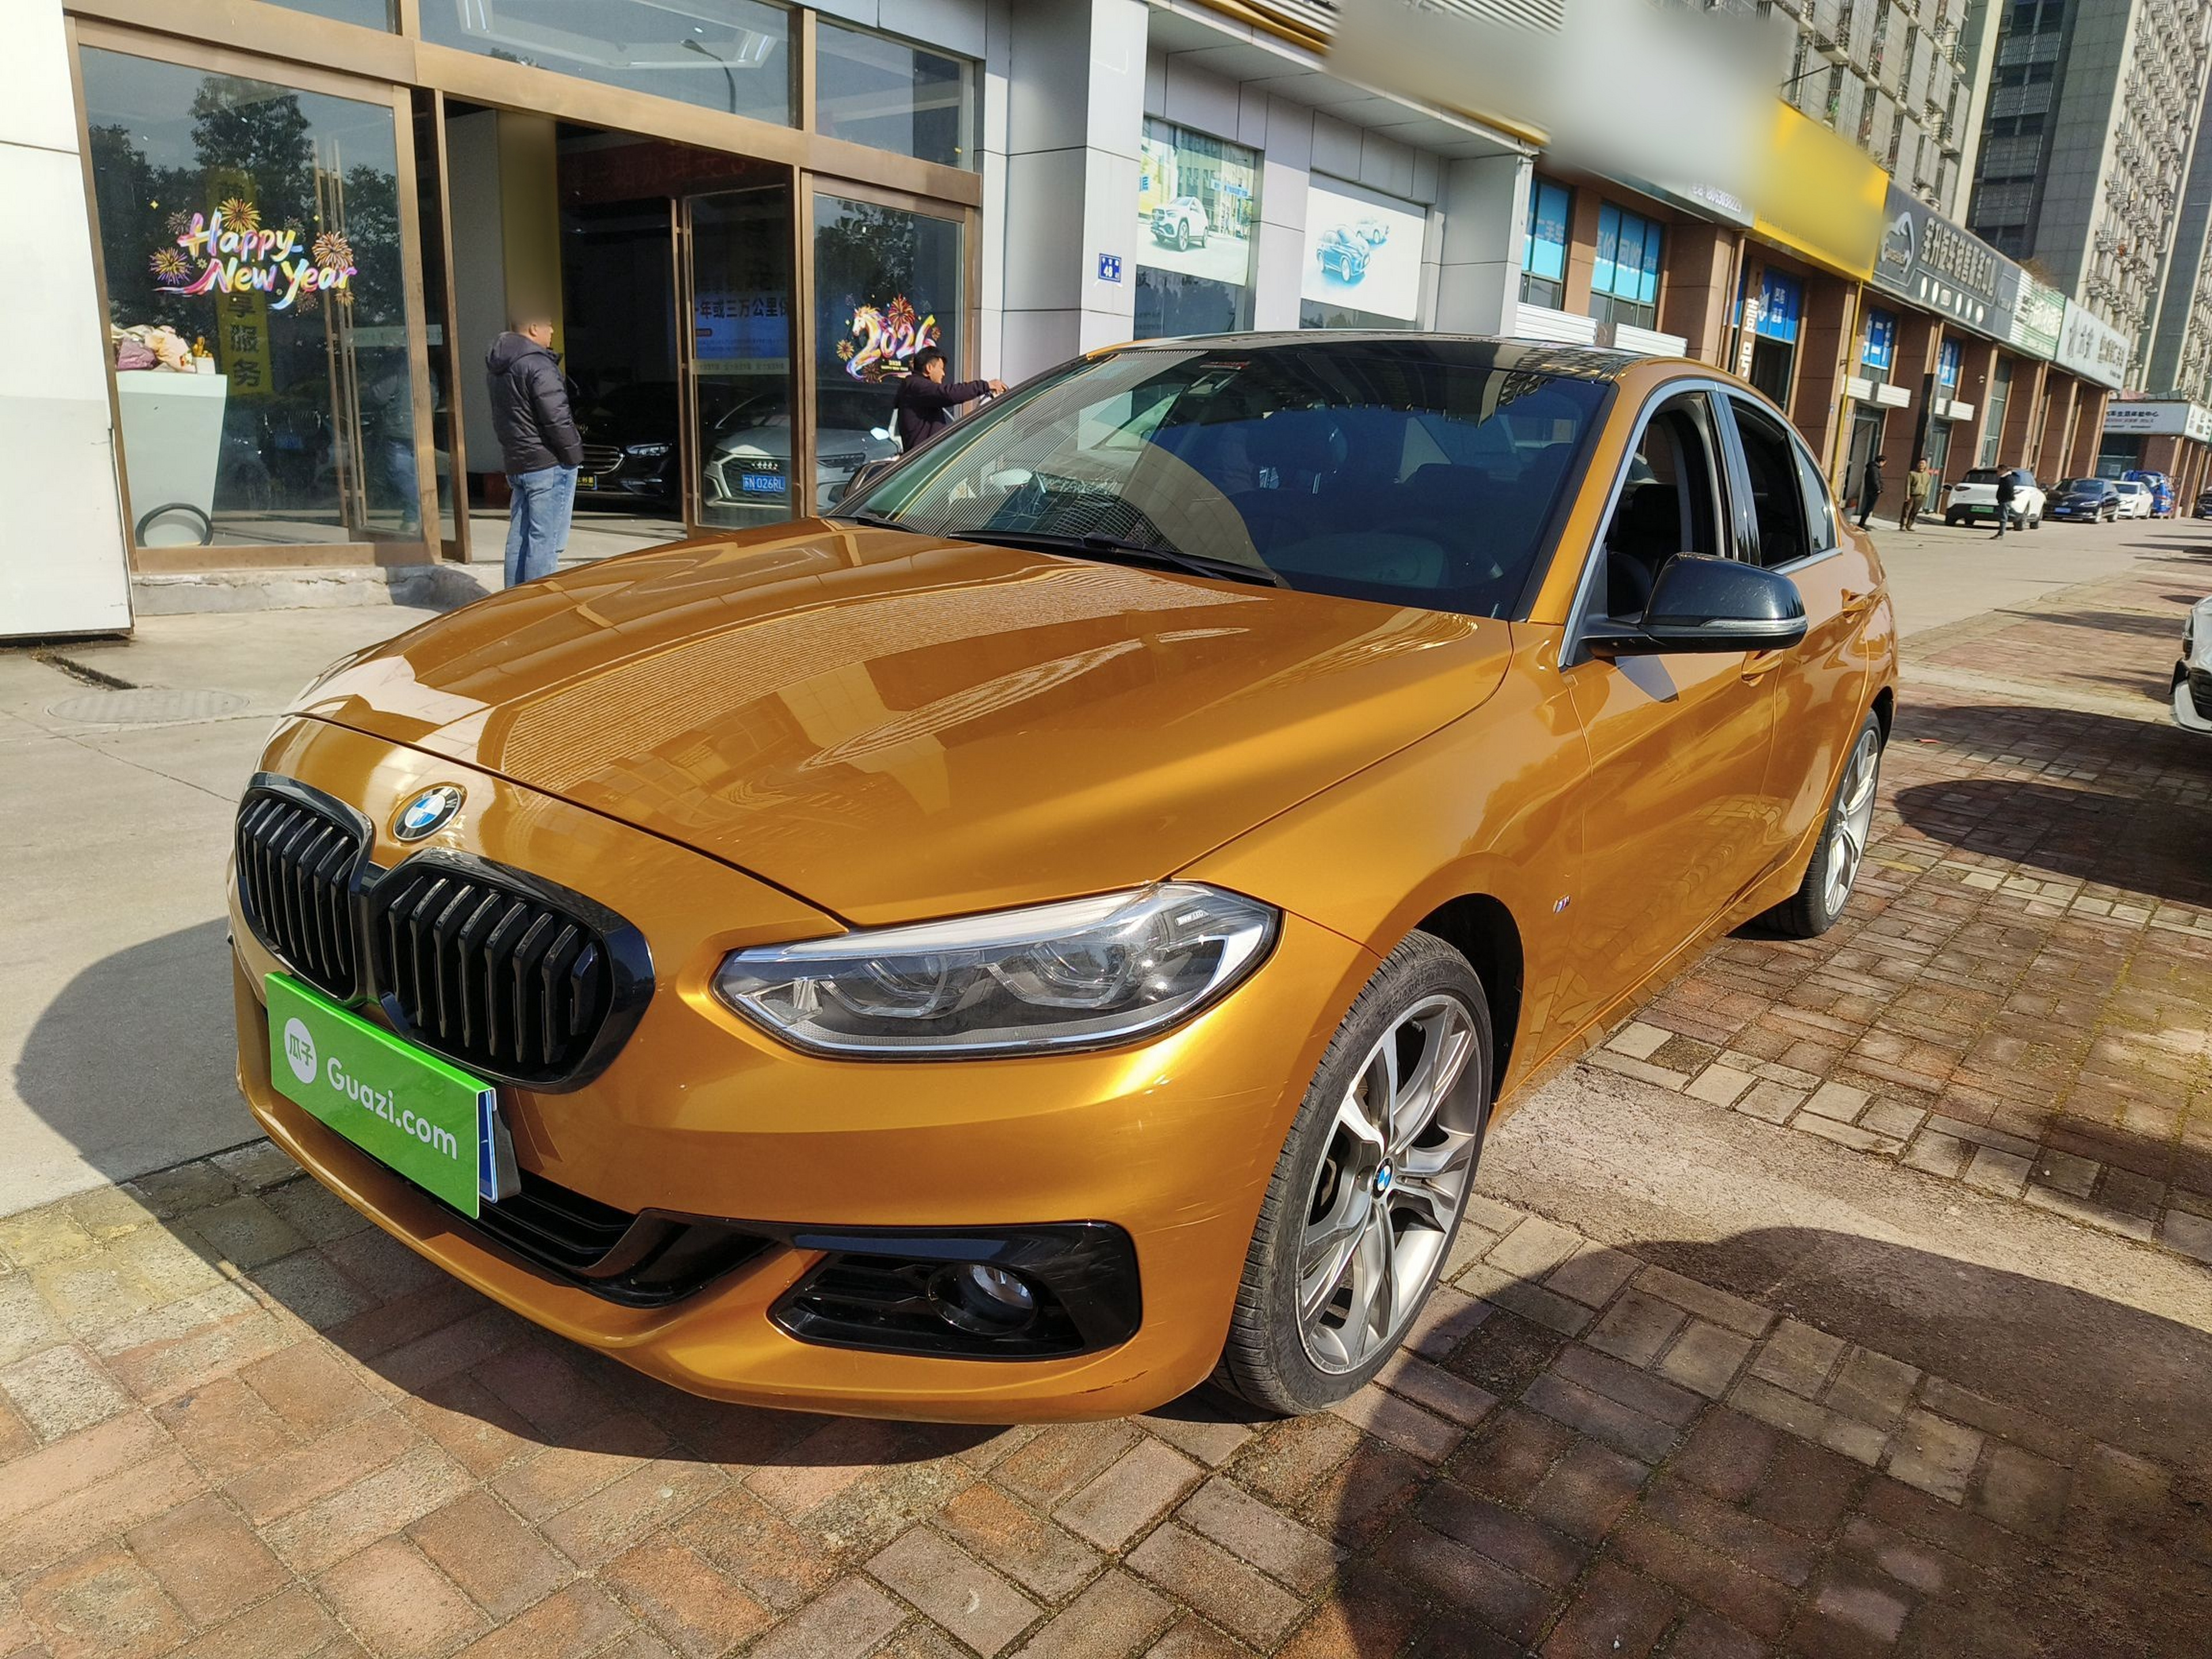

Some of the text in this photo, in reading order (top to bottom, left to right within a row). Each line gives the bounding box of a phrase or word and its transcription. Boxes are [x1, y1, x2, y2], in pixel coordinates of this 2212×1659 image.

[177, 207, 304, 262] Happy
[161, 257, 358, 310] New Year
[694, 297, 788, 319] 年或三万公里
[289, 1033, 314, 1066] 瓜子
[326, 1056, 458, 1160] Guazi.com
